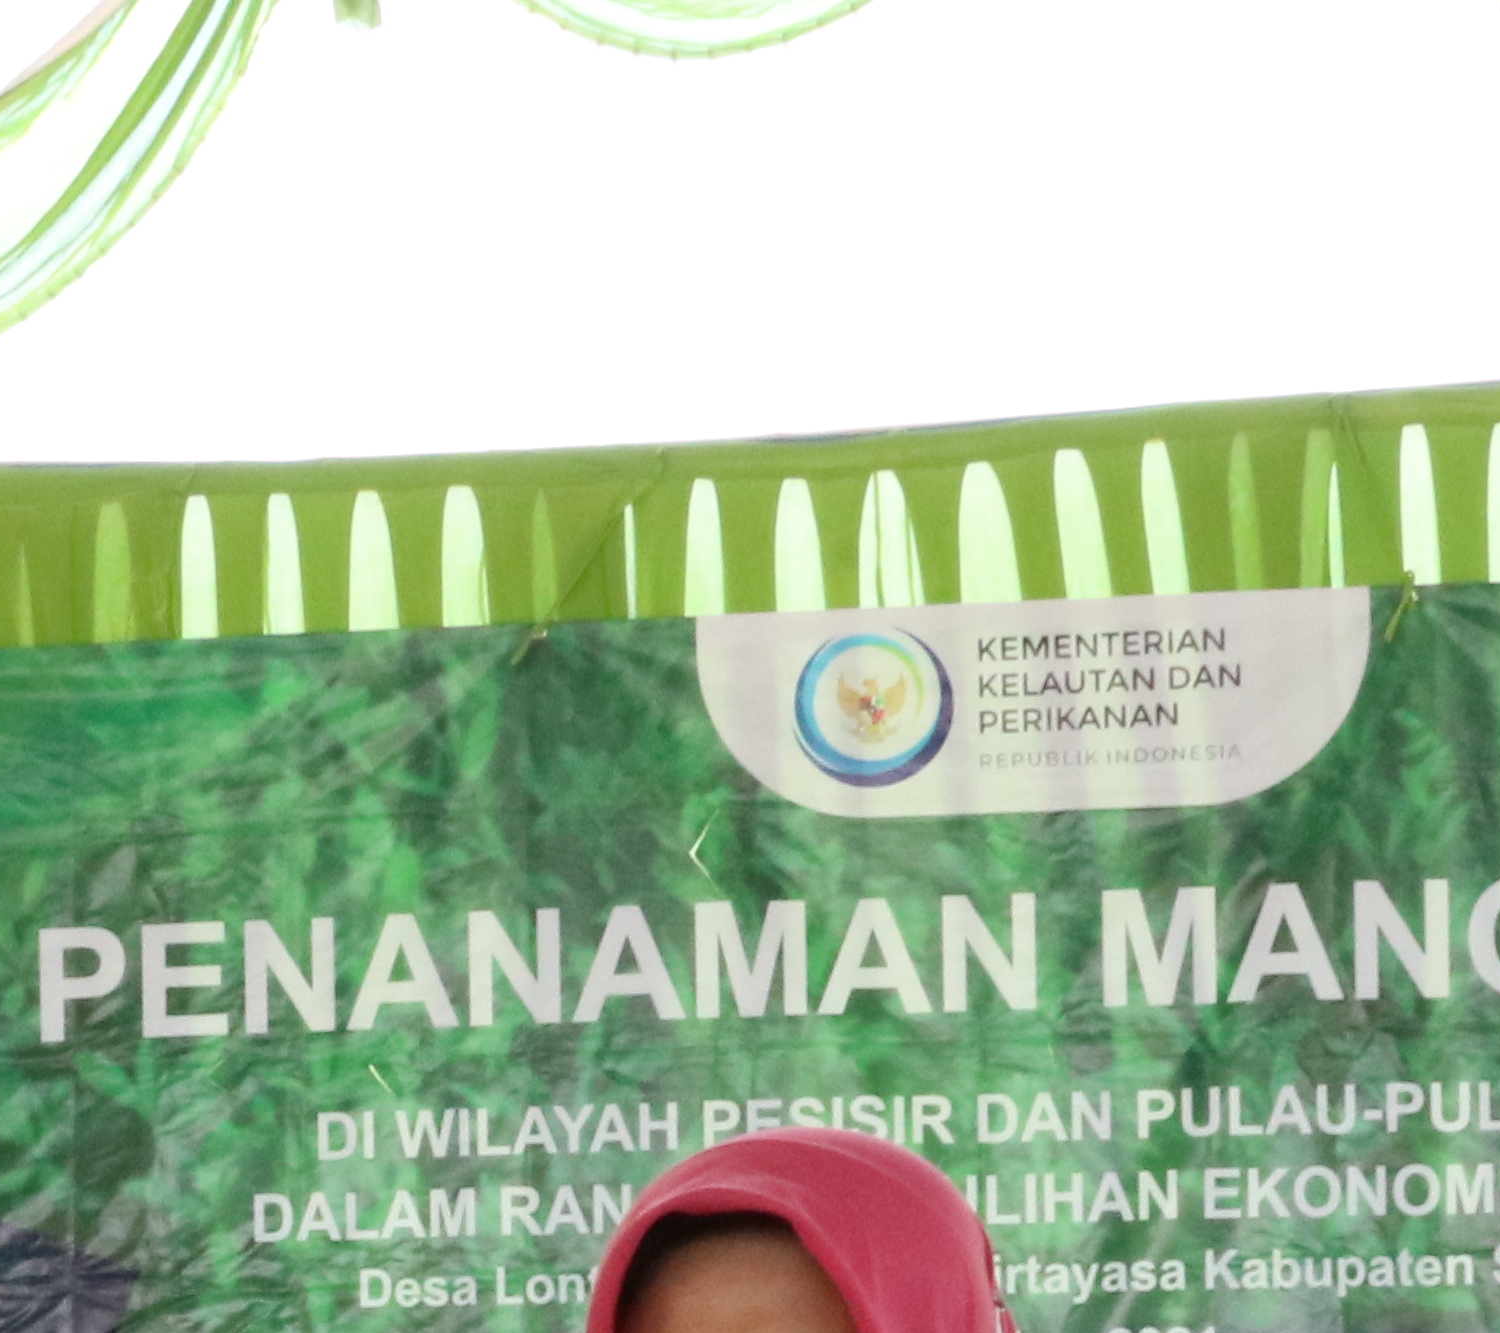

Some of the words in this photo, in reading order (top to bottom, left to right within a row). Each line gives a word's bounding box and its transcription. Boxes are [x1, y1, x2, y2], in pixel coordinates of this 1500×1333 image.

[977, 626, 1226, 661] KEMENTERIAN
[978, 666, 1155, 698] KELAUTAN
[1168, 663, 1241, 690] DAN
[979, 702, 1178, 734] PERIKANAN
[979, 743, 1097, 768] REPUBLIK
[1106, 742, 1241, 765] INDONESIA
[37, 890, 1038, 1044] PENANAMAN
[316, 1110, 374, 1162] DI
[393, 1101, 681, 1158] WILAYAH
[975, 1091, 1113, 1144] DAN
[251, 1187, 478, 1243] DALAM
[358, 1268, 478, 1309] Desa
[1204, 1247, 1475, 1299] Kabupaten
